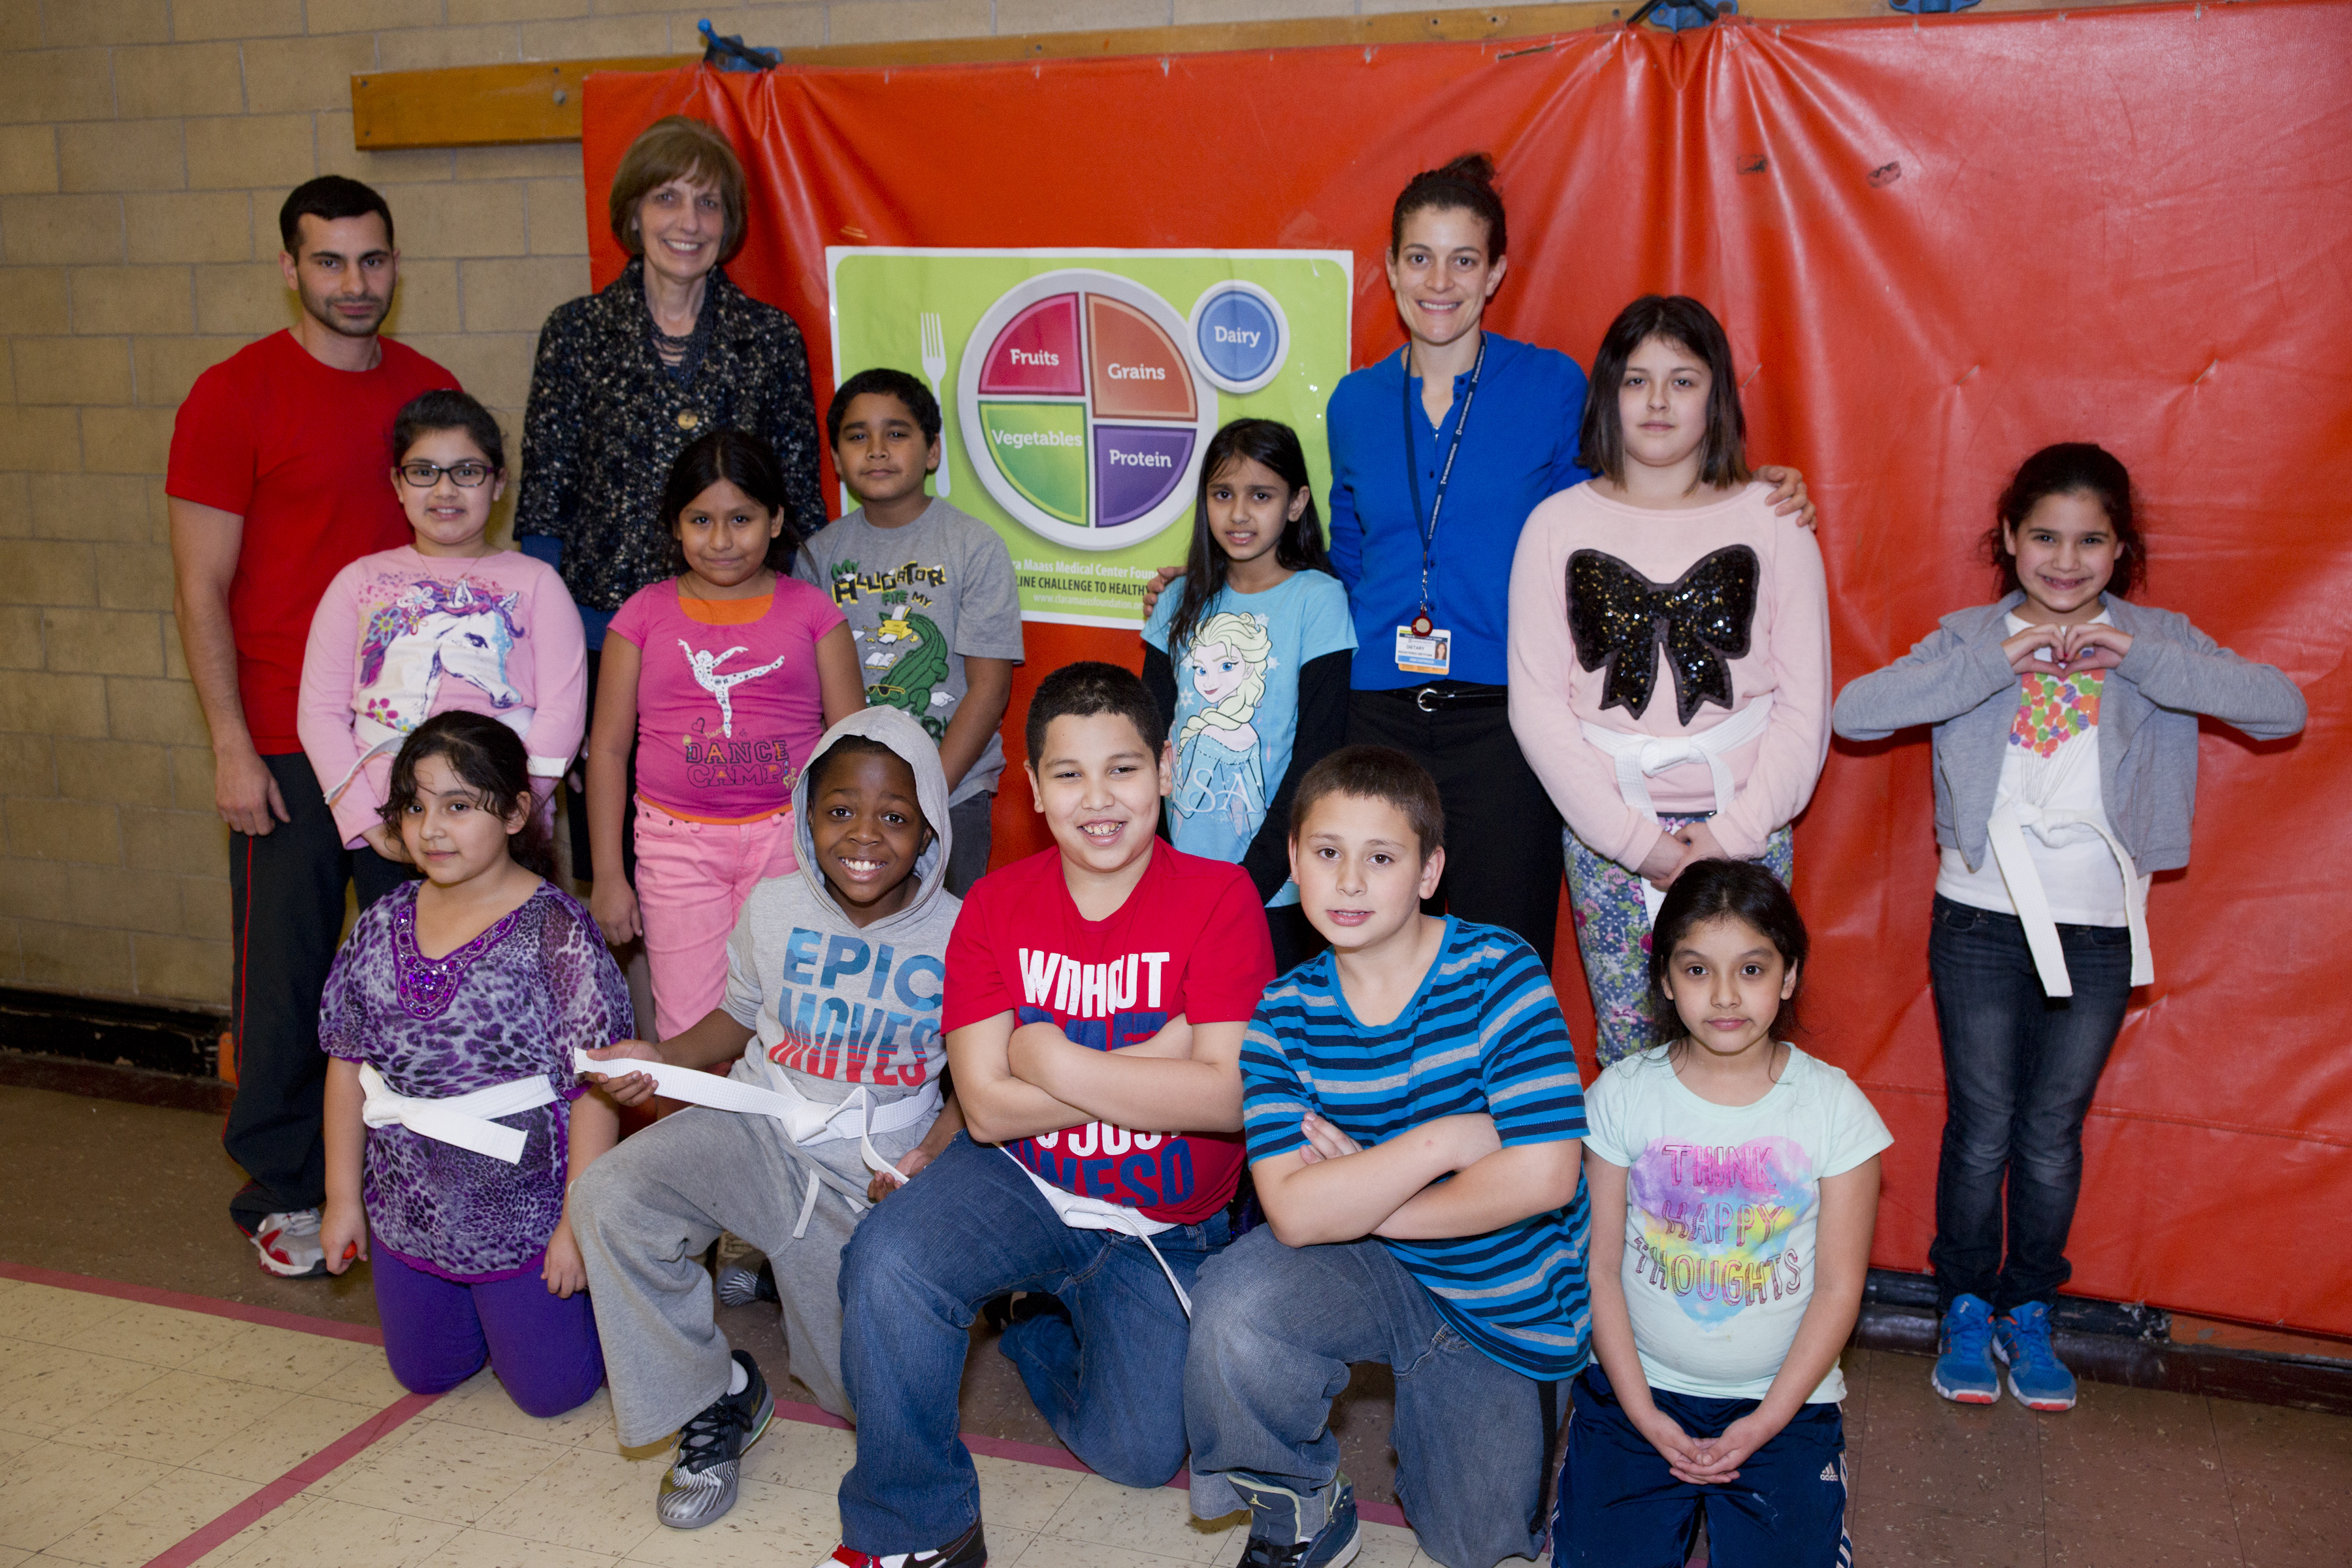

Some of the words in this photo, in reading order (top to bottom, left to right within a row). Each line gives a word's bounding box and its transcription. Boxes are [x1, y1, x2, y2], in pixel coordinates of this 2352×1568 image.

[1214, 325, 1261, 347] Dairy
[1010, 348, 1059, 367] Fruits
[1107, 363, 1166, 381] Grains
[991, 429, 1083, 448] Vegetables
[1109, 449, 1172, 468] Protein
[1024, 559, 1054, 573] Maass
[1055, 561, 1094, 576] Medical
[1095, 564, 1128, 578] Center
[832, 560, 947, 608] ALLIGATOR
[1039, 577, 1092, 592] CHALLENGE
[1095, 581, 1107, 593] TO
[882, 589, 908, 606] ATE
[911, 591, 932, 608] MY
[1034, 593, 1144, 610] www.claramaassfoundation.or
[686, 740, 789, 764] DANCE
[783, 927, 946, 1011] EPIC
[768, 986, 940, 1086] MOVES
[1662, 1145, 1776, 1189] THINK
[1662, 1200, 1785, 1247] HAPPY
[1634, 1236, 1801, 1307] THOUGHTS
